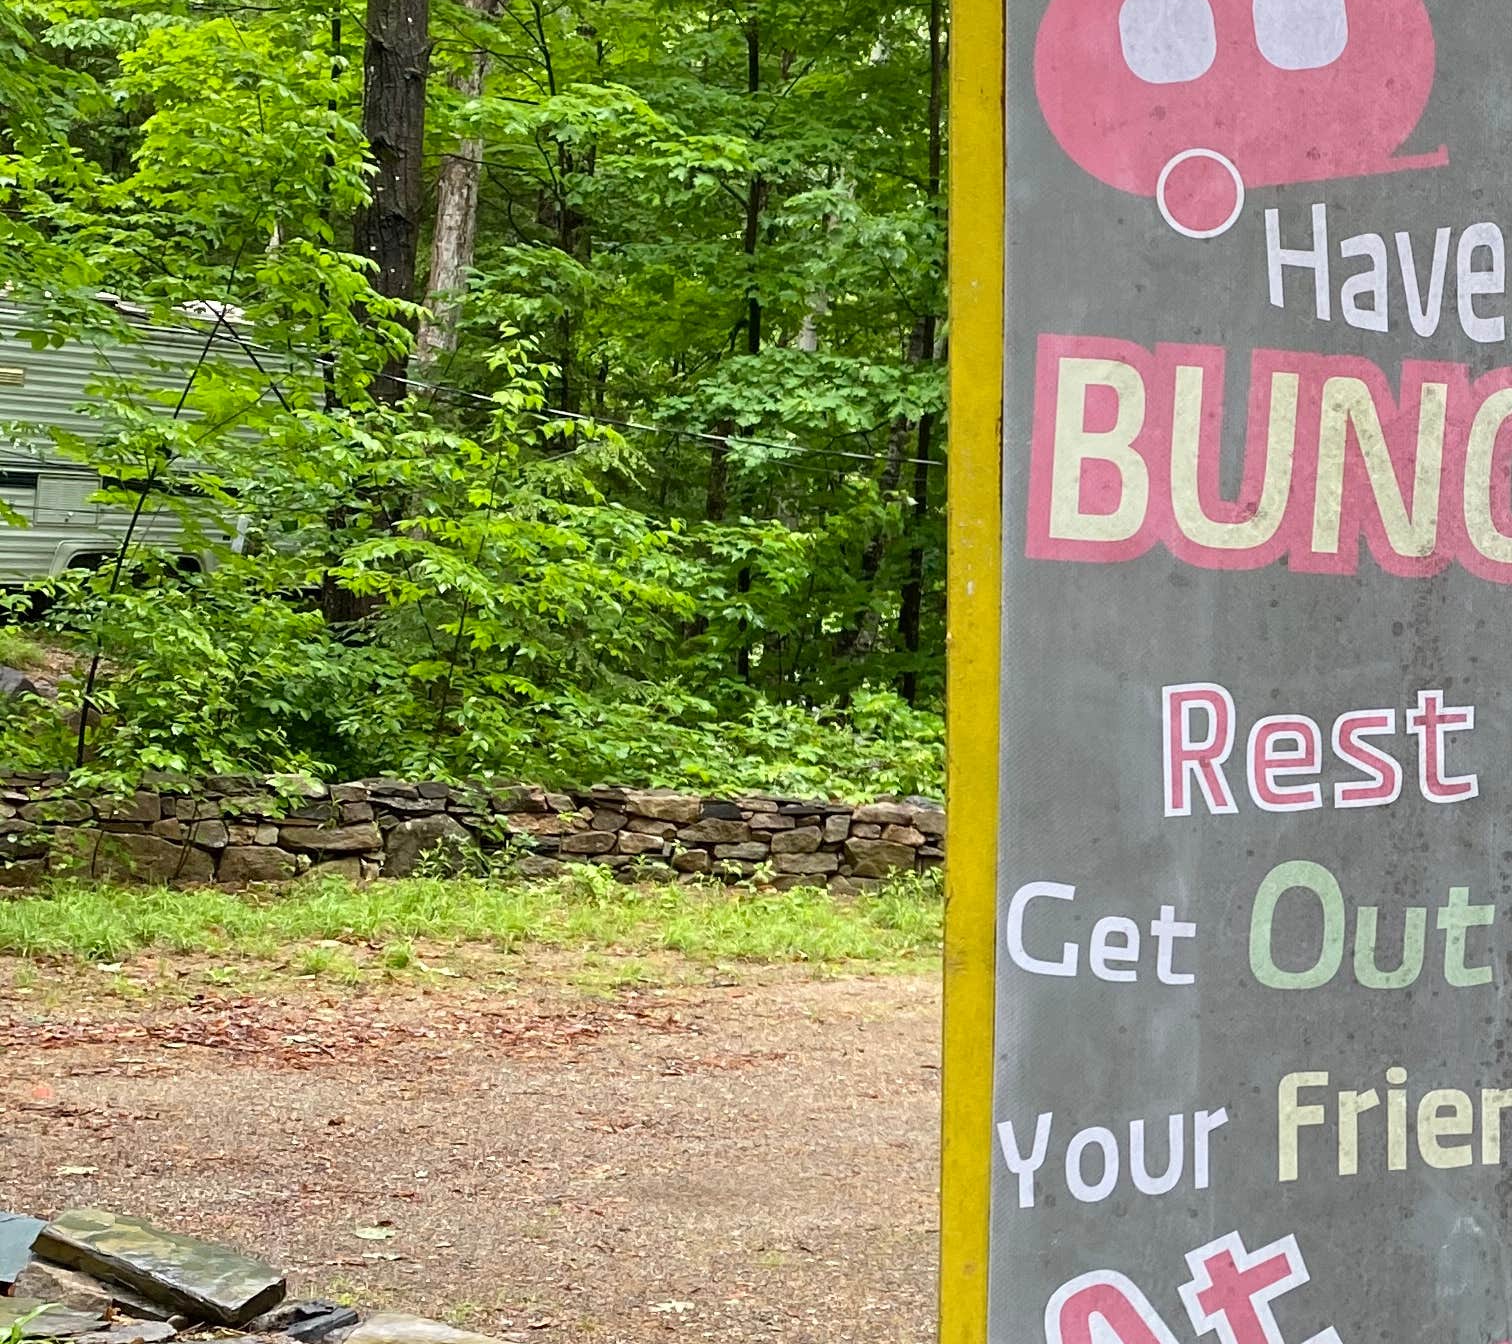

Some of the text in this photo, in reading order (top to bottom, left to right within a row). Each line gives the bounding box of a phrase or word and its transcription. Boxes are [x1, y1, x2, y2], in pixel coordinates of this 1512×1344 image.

[1265, 203, 1506, 344] Have
[1161, 682, 1480, 817] Rest
[1006, 881, 1197, 985] Get
[1249, 860, 1496, 990] Out
[997, 1107, 1230, 1208] Your
